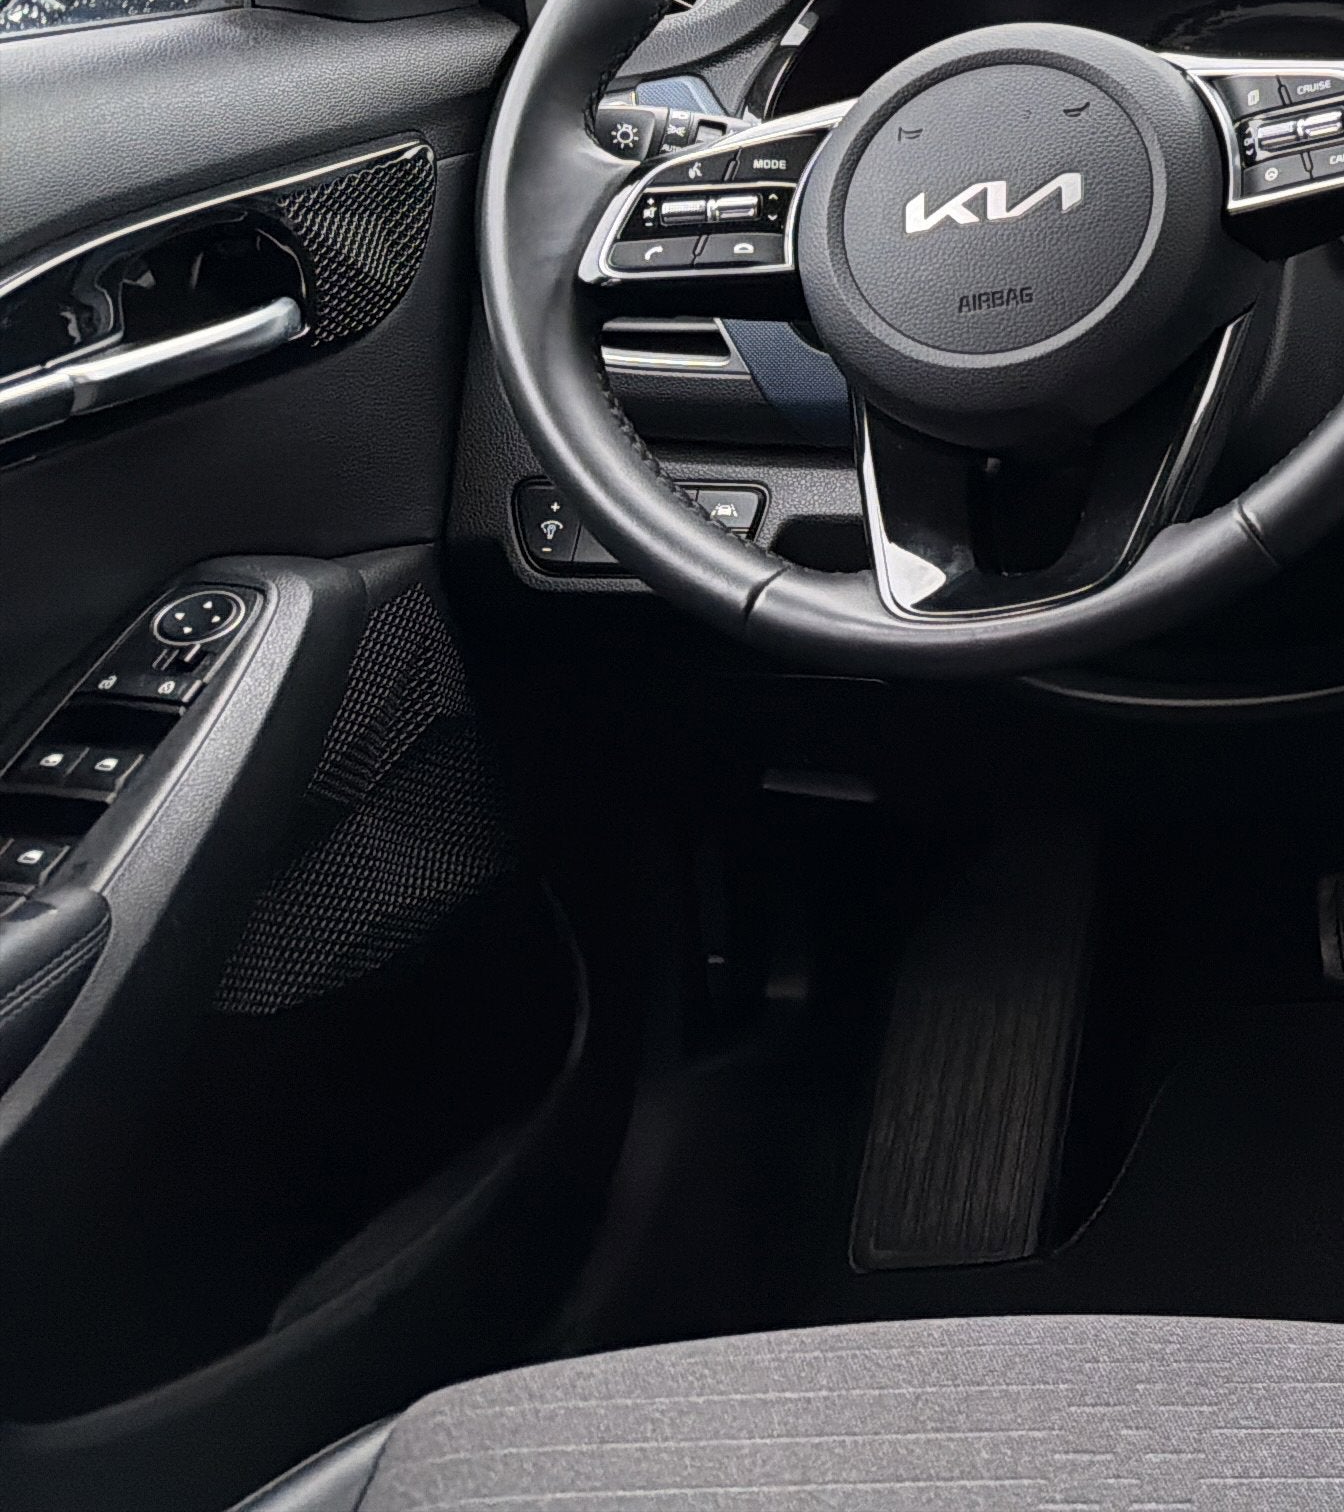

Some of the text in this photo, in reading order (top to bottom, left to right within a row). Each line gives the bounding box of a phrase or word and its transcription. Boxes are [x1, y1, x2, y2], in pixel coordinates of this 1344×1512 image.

[1296, 79, 1332, 95] CRUISE
[752, 158, 787, 170] MODE
[957, 286, 1034, 314] AIRBAG
